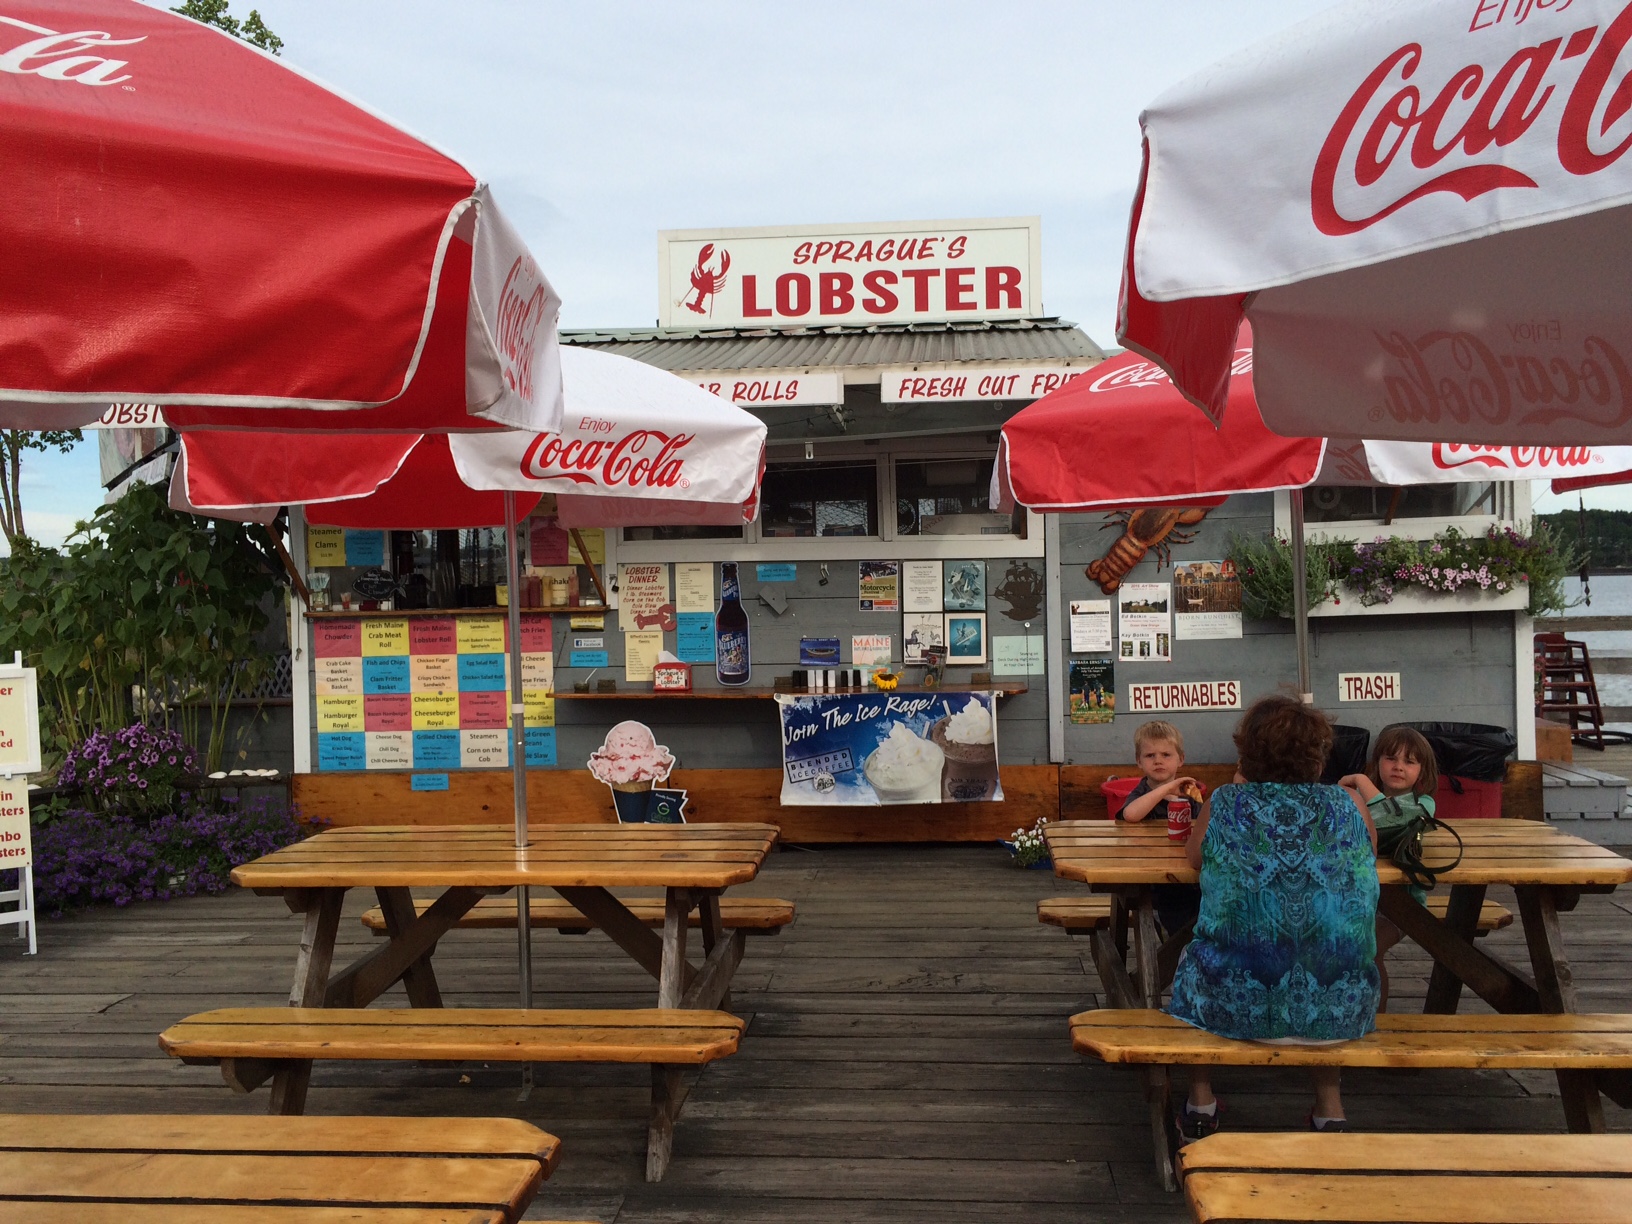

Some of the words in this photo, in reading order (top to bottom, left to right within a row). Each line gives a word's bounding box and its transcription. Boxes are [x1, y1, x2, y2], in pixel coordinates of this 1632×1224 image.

[793, 235, 968, 265] SPRAGUE'S
[742, 266, 1023, 317] LOBSTER
[732, 380, 799, 403] ROLLS
[899, 375, 966, 399] FRESH
[978, 374, 1021, 397] CUT
[578, 416, 617, 434] Enjoy
[520, 430, 696, 488] Coca-Cola
[315, 541, 338, 549] Clams
[625, 566, 661, 575] LOBSTER
[628, 575, 658, 583] DINNER
[860, 584, 896, 592] Motorcycle
[853, 638, 890, 646] MAINE
[657, 668, 684, 677] Sprague's
[1133, 681, 1237, 710] RETURNABLES
[1344, 675, 1395, 700] TRASH
[323, 712, 358, 720] Hamburger
[784, 722, 819, 746] Join
[821, 706, 854, 730] The
[854, 703, 882, 722] Ice
[883, 694, 937, 718] Rage!
[790, 752, 848, 770] BLENDED
